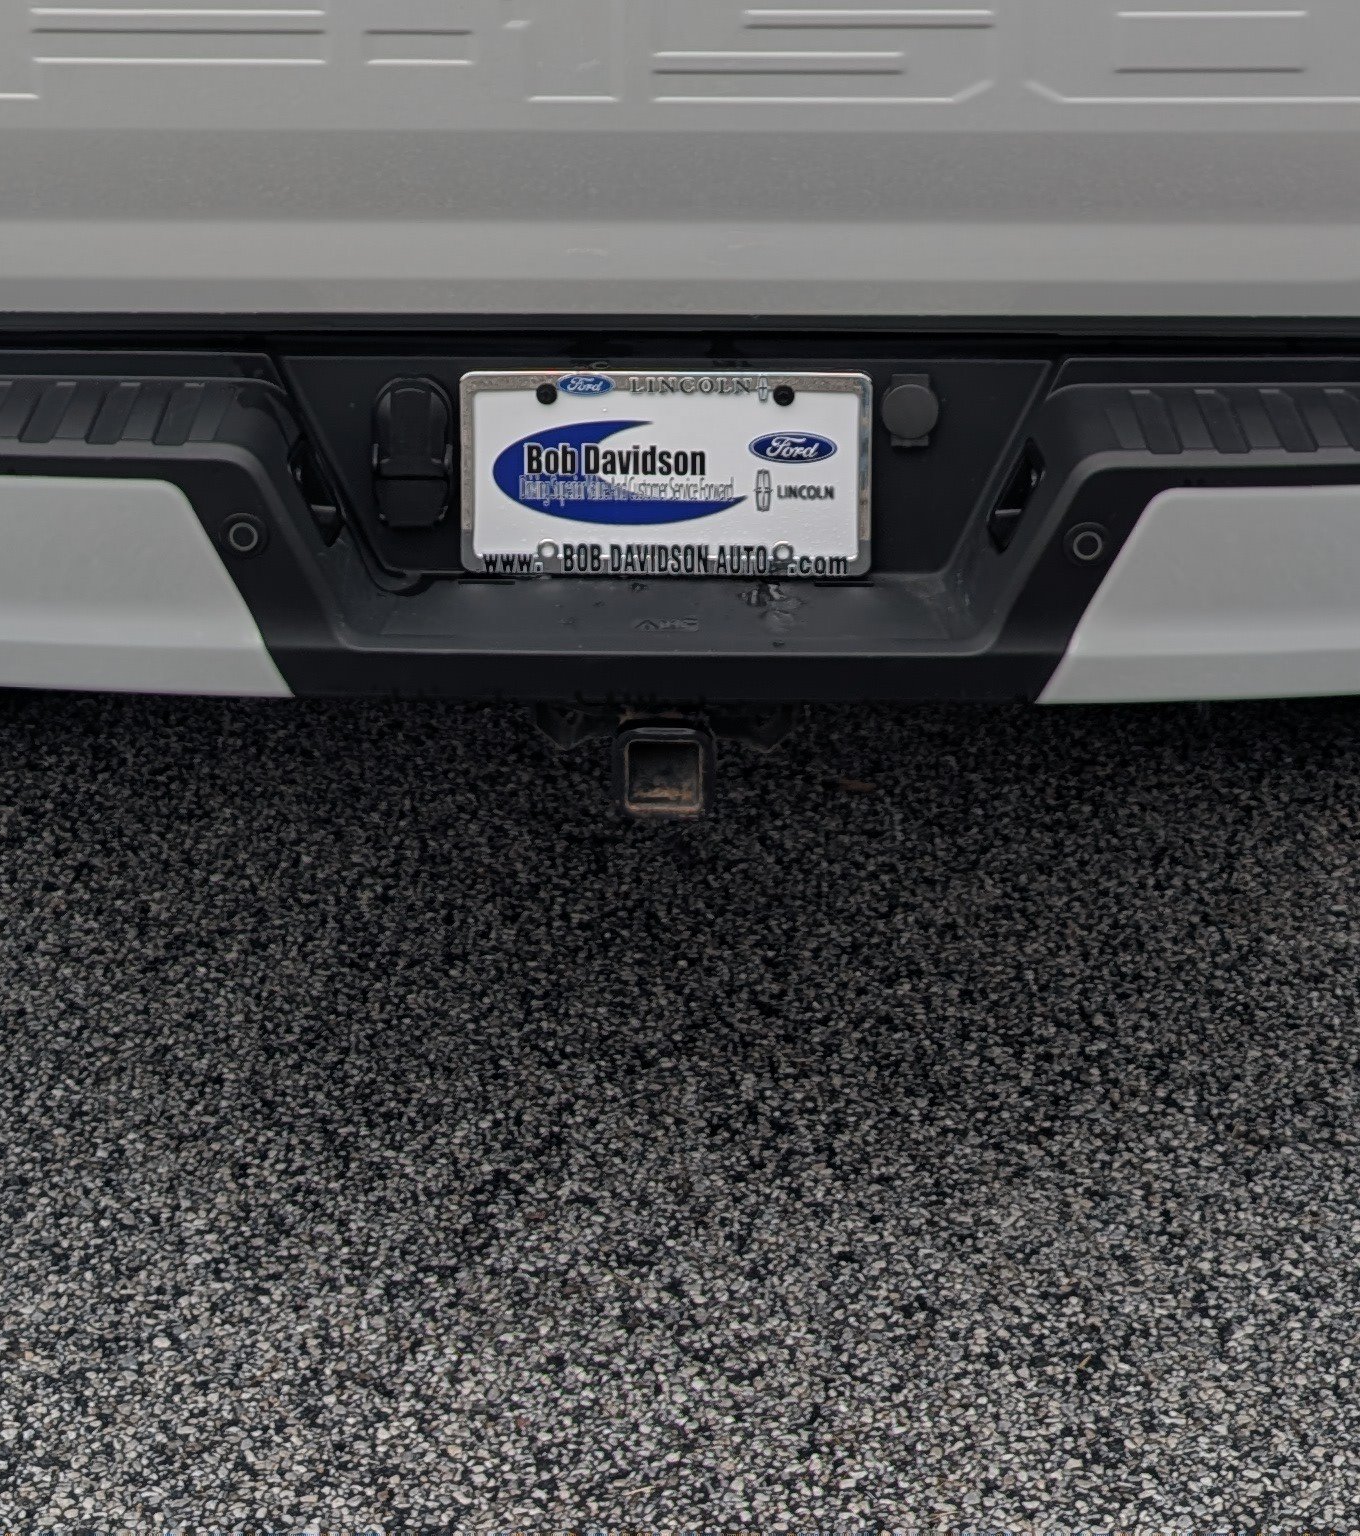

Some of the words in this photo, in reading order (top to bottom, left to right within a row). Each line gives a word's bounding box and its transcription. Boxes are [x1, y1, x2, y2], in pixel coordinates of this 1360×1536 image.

[566, 377, 603, 392] Ford
[628, 376, 753, 395] LINCOLN
[765, 435, 821, 458] Ford
[524, 442, 578, 476] Bob
[582, 443, 706, 477] Davidson
[776, 485, 835, 500] LINCOLN
